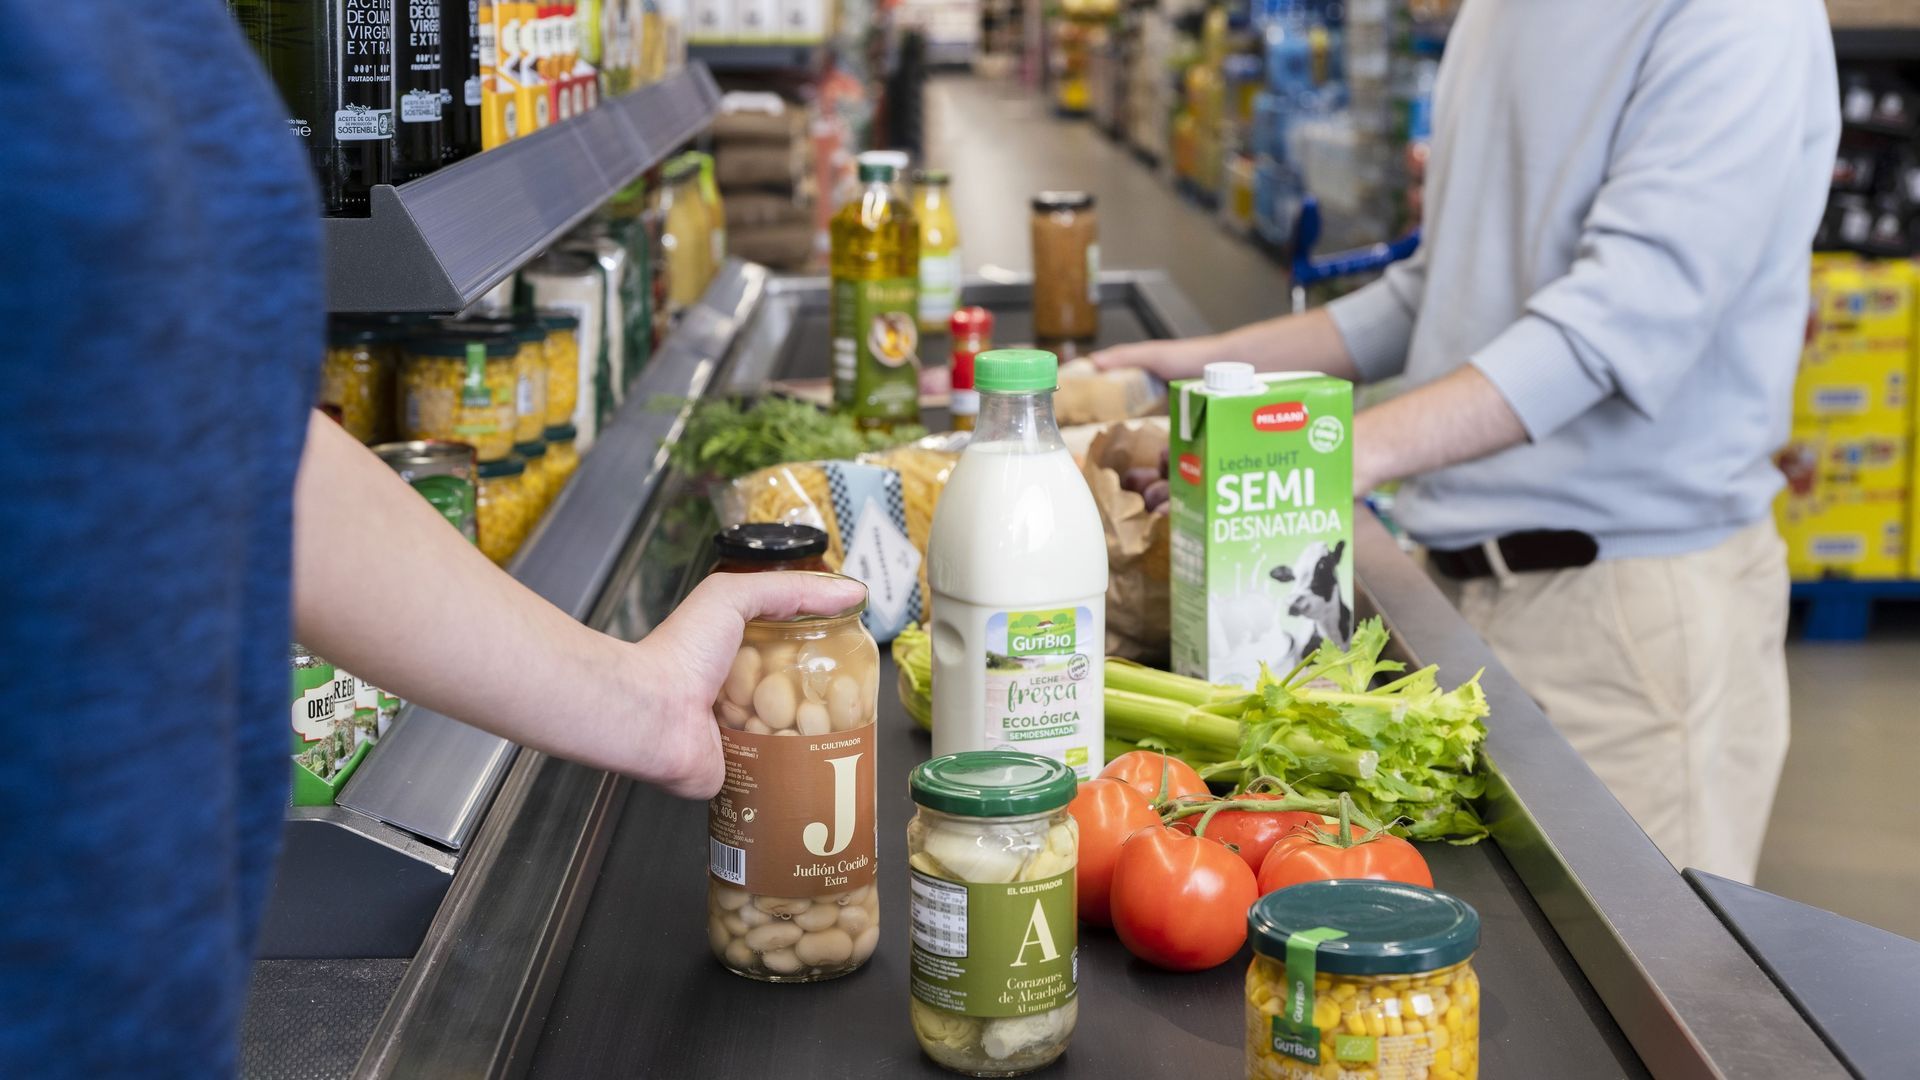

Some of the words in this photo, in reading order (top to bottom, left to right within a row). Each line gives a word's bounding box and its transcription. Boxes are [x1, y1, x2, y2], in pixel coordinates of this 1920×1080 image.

[347, 10, 365, 24] DE
[410, 5, 424, 19] DE
[347, 26, 390, 40] VIRGEN
[347, 41, 390, 55] EXTRA
[337, 126, 377, 134] SOSTENIBLE
[1256, 411, 1305, 425] MILSANI
[1219, 454, 1262, 471] Leche
[1266, 451, 1299, 467] UHT
[1215, 467, 1315, 515] SEMI
[1214, 508, 1342, 543] DESNATADA
[1030, 676, 1060, 686] LECHE
[1008, 681, 1078, 713] fresca
[1002, 710, 1081, 729] ECOLÓGICA
[1009, 726, 1075, 740] SEMIDESNATADA
[810, 743, 820, 751] EL
[821, 737, 861, 751] CULTIVADOR
[802, 752, 864, 857] J
[720, 806, 738, 822] 400g
[793, 862, 835, 877] Judión
[838, 854, 869, 873] Cocido
[825, 876, 848, 887] Extra
[1007, 887, 1019, 896] EL
[1019, 879, 1064, 895] CULTIVADOR
[1010, 898, 1061, 967] A
[1007, 972, 1063, 990] Corazones
[998, 991, 1014, 1004] de
[1017, 981, 1067, 1003] Alcachofa
[1016, 1003, 1026, 1014] Al
[1028, 997, 1057, 1013] natural
